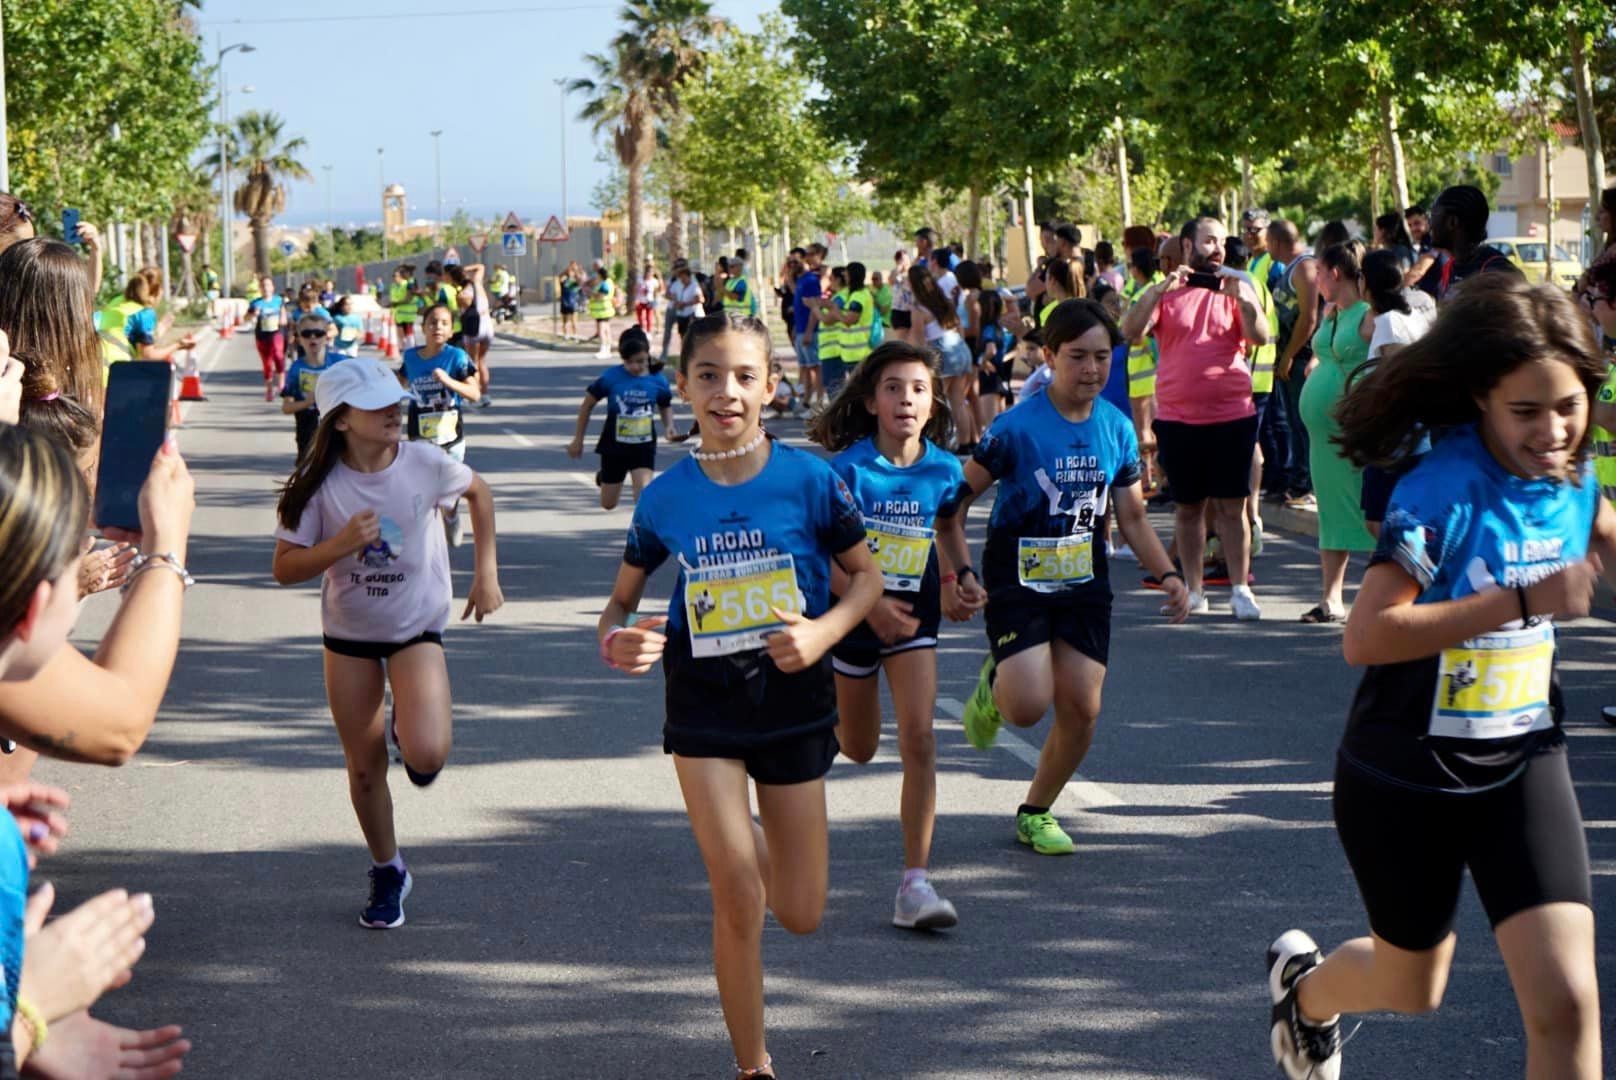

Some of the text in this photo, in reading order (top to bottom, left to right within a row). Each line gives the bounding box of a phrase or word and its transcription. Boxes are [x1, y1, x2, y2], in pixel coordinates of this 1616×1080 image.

[1066, 456, 1097, 469] ROAD
[1055, 470, 1105, 484] RUNNING
[886, 500, 919, 514] ROAD
[695, 528, 763, 553] II ROAD
[880, 543, 923, 572] 501
[1042, 551, 1089, 577] 566
[351, 572, 360, 584] TE
[720, 580, 795, 626] 565
